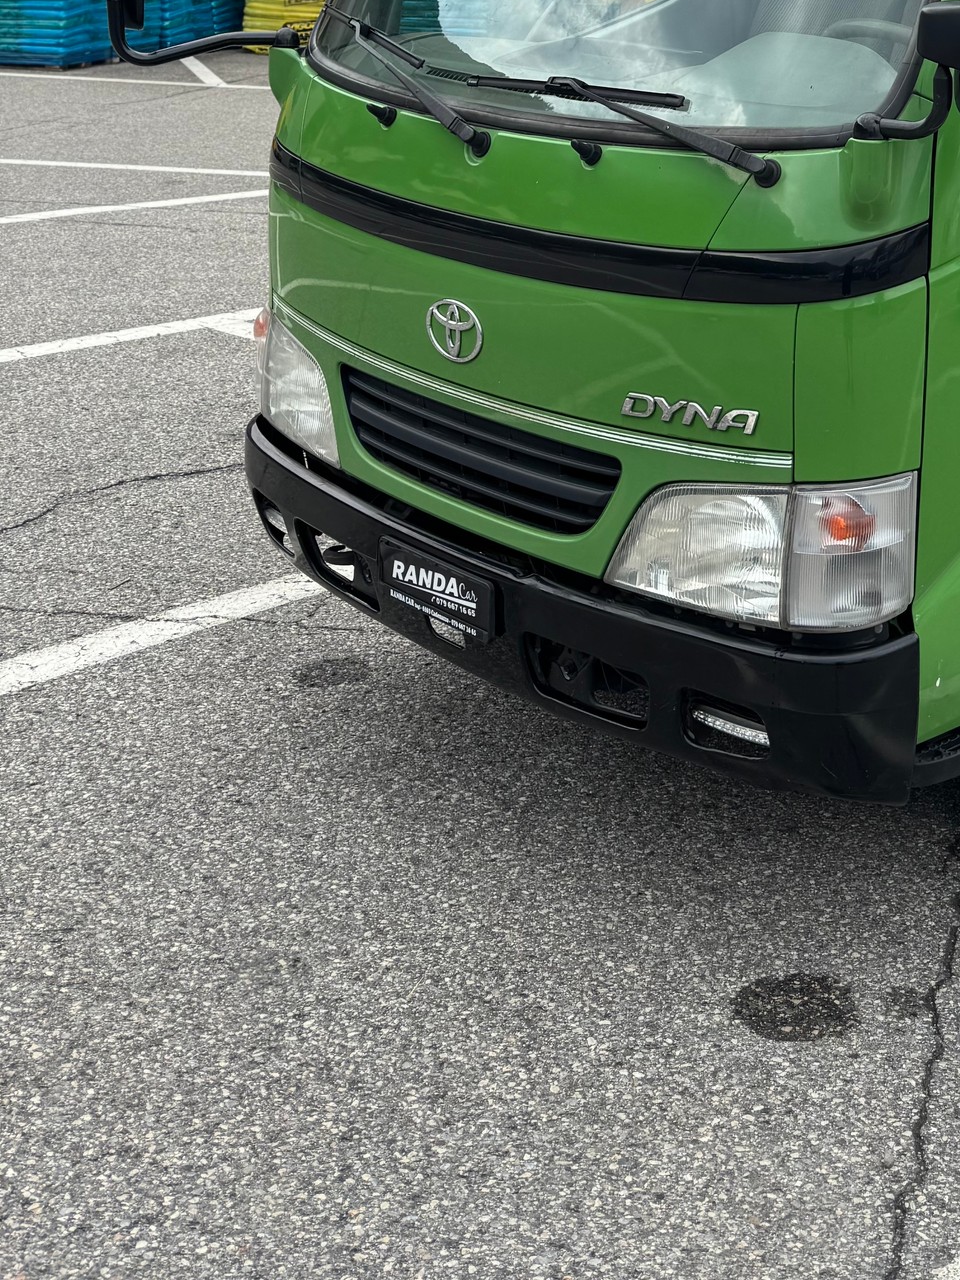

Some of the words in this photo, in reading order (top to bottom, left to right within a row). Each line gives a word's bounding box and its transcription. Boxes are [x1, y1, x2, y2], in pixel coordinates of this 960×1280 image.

[621, 392, 759, 435] DYNA
[392, 560, 459, 597] RANDA
[459, 582, 478, 602] Car
[436, 597, 447, 607] 079
[447, 601, 458, 611] 667
[459, 605, 467, 614] 16
[467, 608, 476, 617] 65
